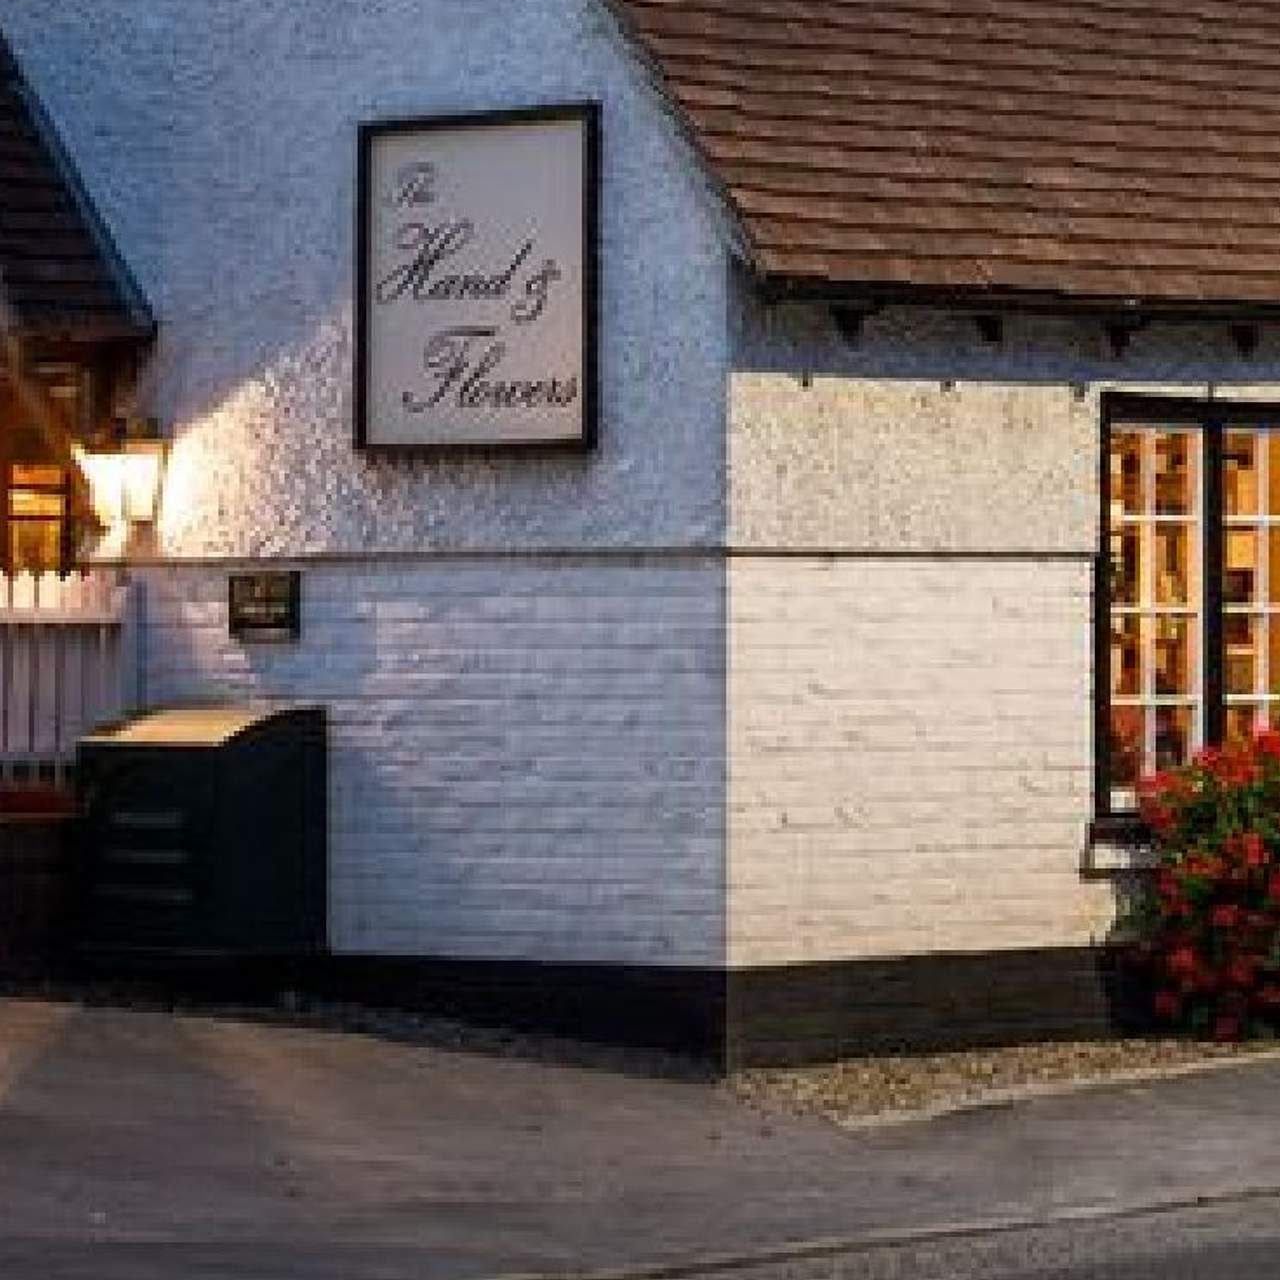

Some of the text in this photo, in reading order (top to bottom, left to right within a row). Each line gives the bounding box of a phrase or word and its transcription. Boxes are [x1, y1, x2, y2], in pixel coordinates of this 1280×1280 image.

[388, 161, 437, 208] The
[375, 219, 561, 324] Hand &
[401, 325, 577, 413] Flowers
